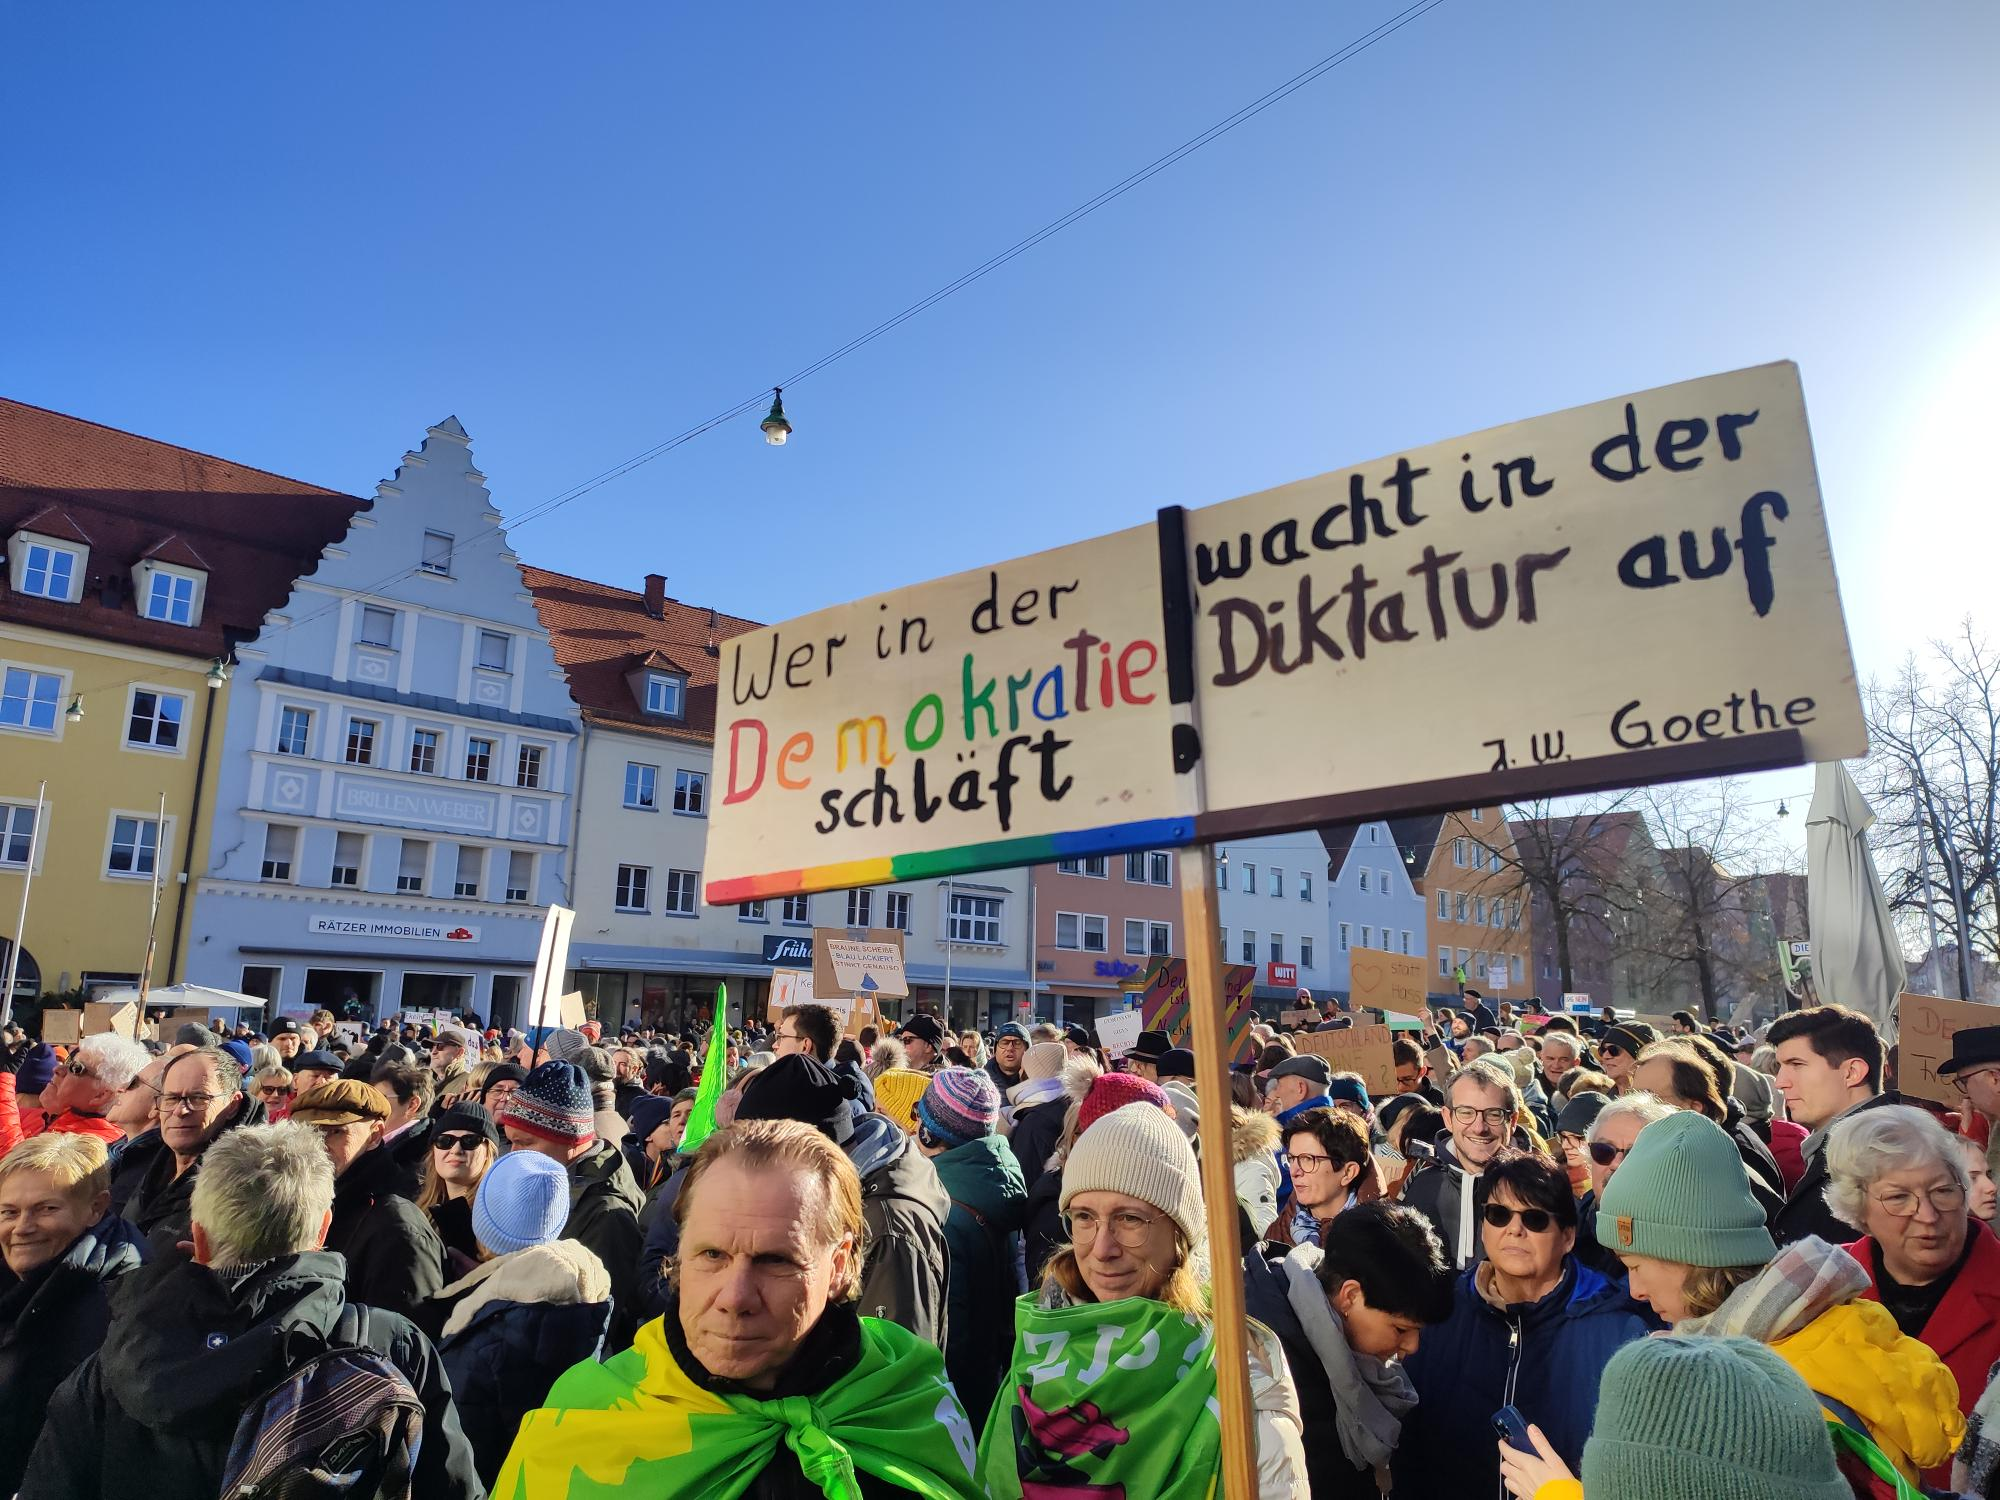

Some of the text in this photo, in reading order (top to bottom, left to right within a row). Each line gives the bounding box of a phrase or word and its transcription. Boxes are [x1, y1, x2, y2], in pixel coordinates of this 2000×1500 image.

[1196, 402, 1760, 586] wacht in der
[1209, 491, 1789, 688] Diktatur auf
[733, 571, 1079, 706] Wer in der
[723, 628, 1158, 805] Demokratie
[1610, 689, 1816, 749] Goethe
[347, 788, 486, 824] BRILLEN WEBER
[815, 730, 1073, 833] schläft
[318, 919, 441, 938] RÄTZER IMMOBILIEN
[829, 943, 861, 952] BRAUNE
[835, 961, 899, 972] STINKT GENAUSO
[1302, 1026, 1391, 1054] DEUTSCHLAND
